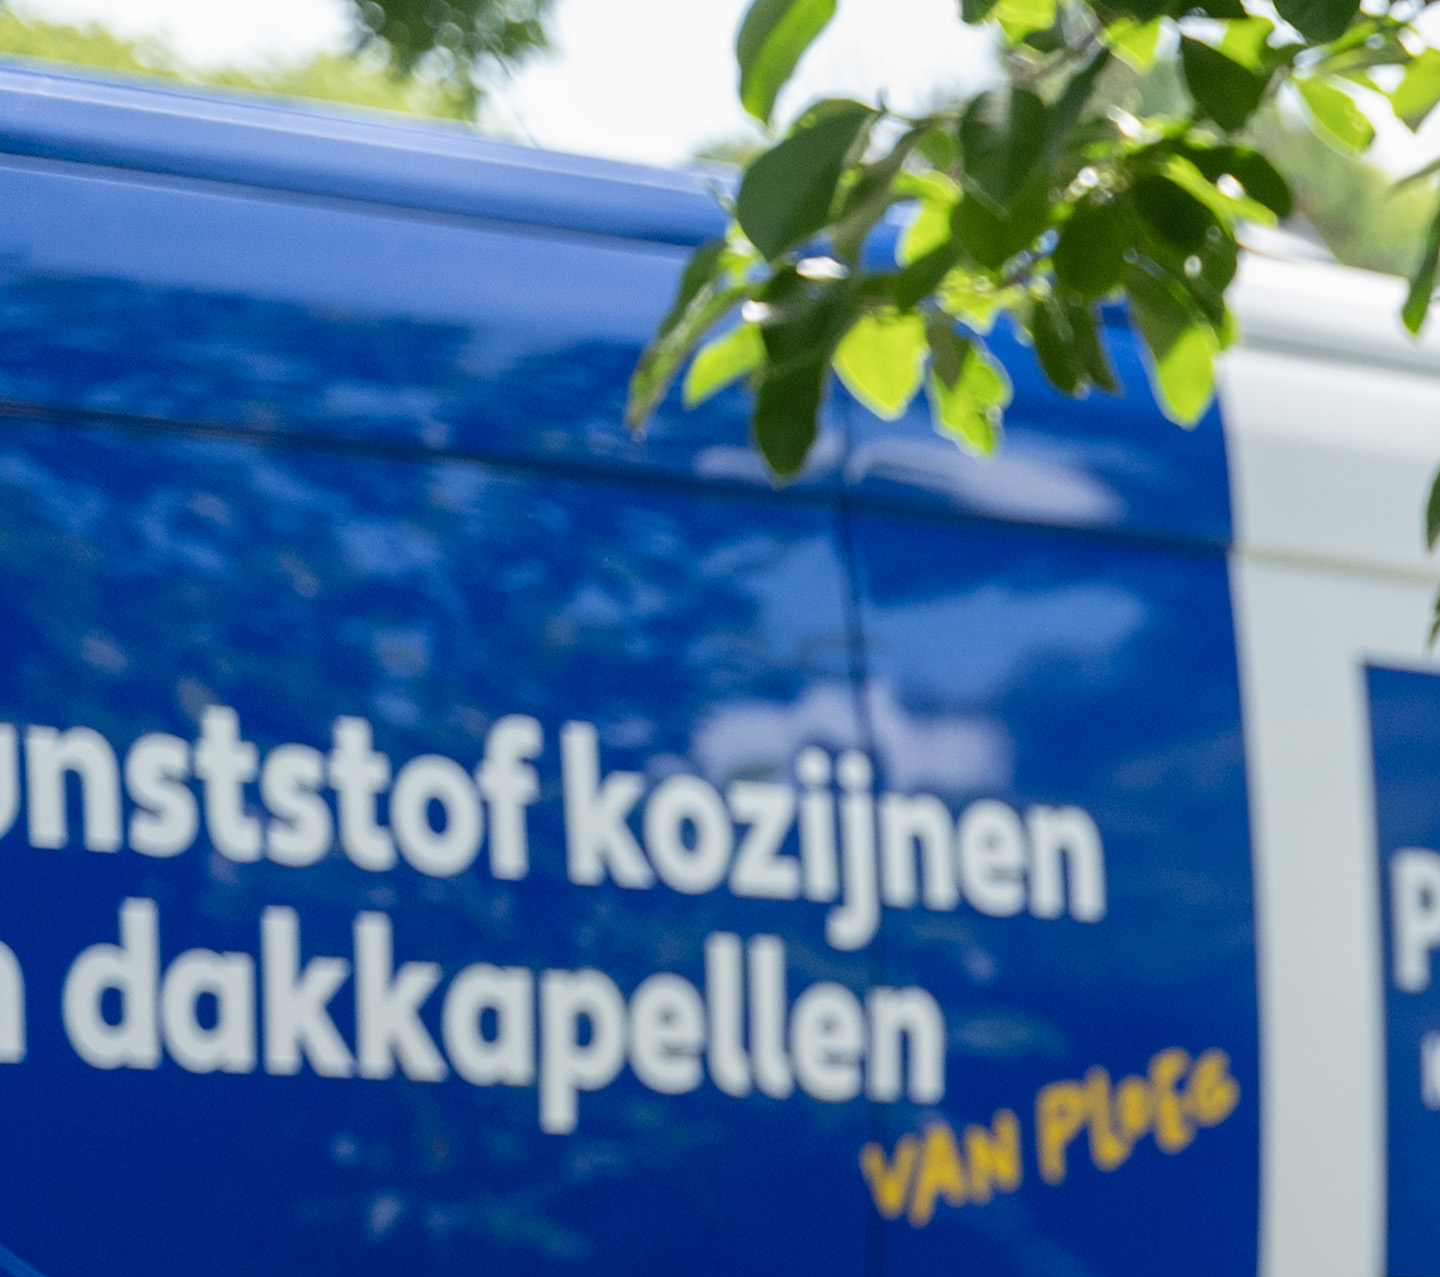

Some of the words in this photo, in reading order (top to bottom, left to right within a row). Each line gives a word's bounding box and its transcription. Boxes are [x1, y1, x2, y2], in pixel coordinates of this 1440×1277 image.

[0, 703, 542, 880] nststof
[561, 719, 1107, 949] kozijnen
[62, 896, 945, 1134] dakkapellen
[860, 1108, 1023, 1228] VAN
